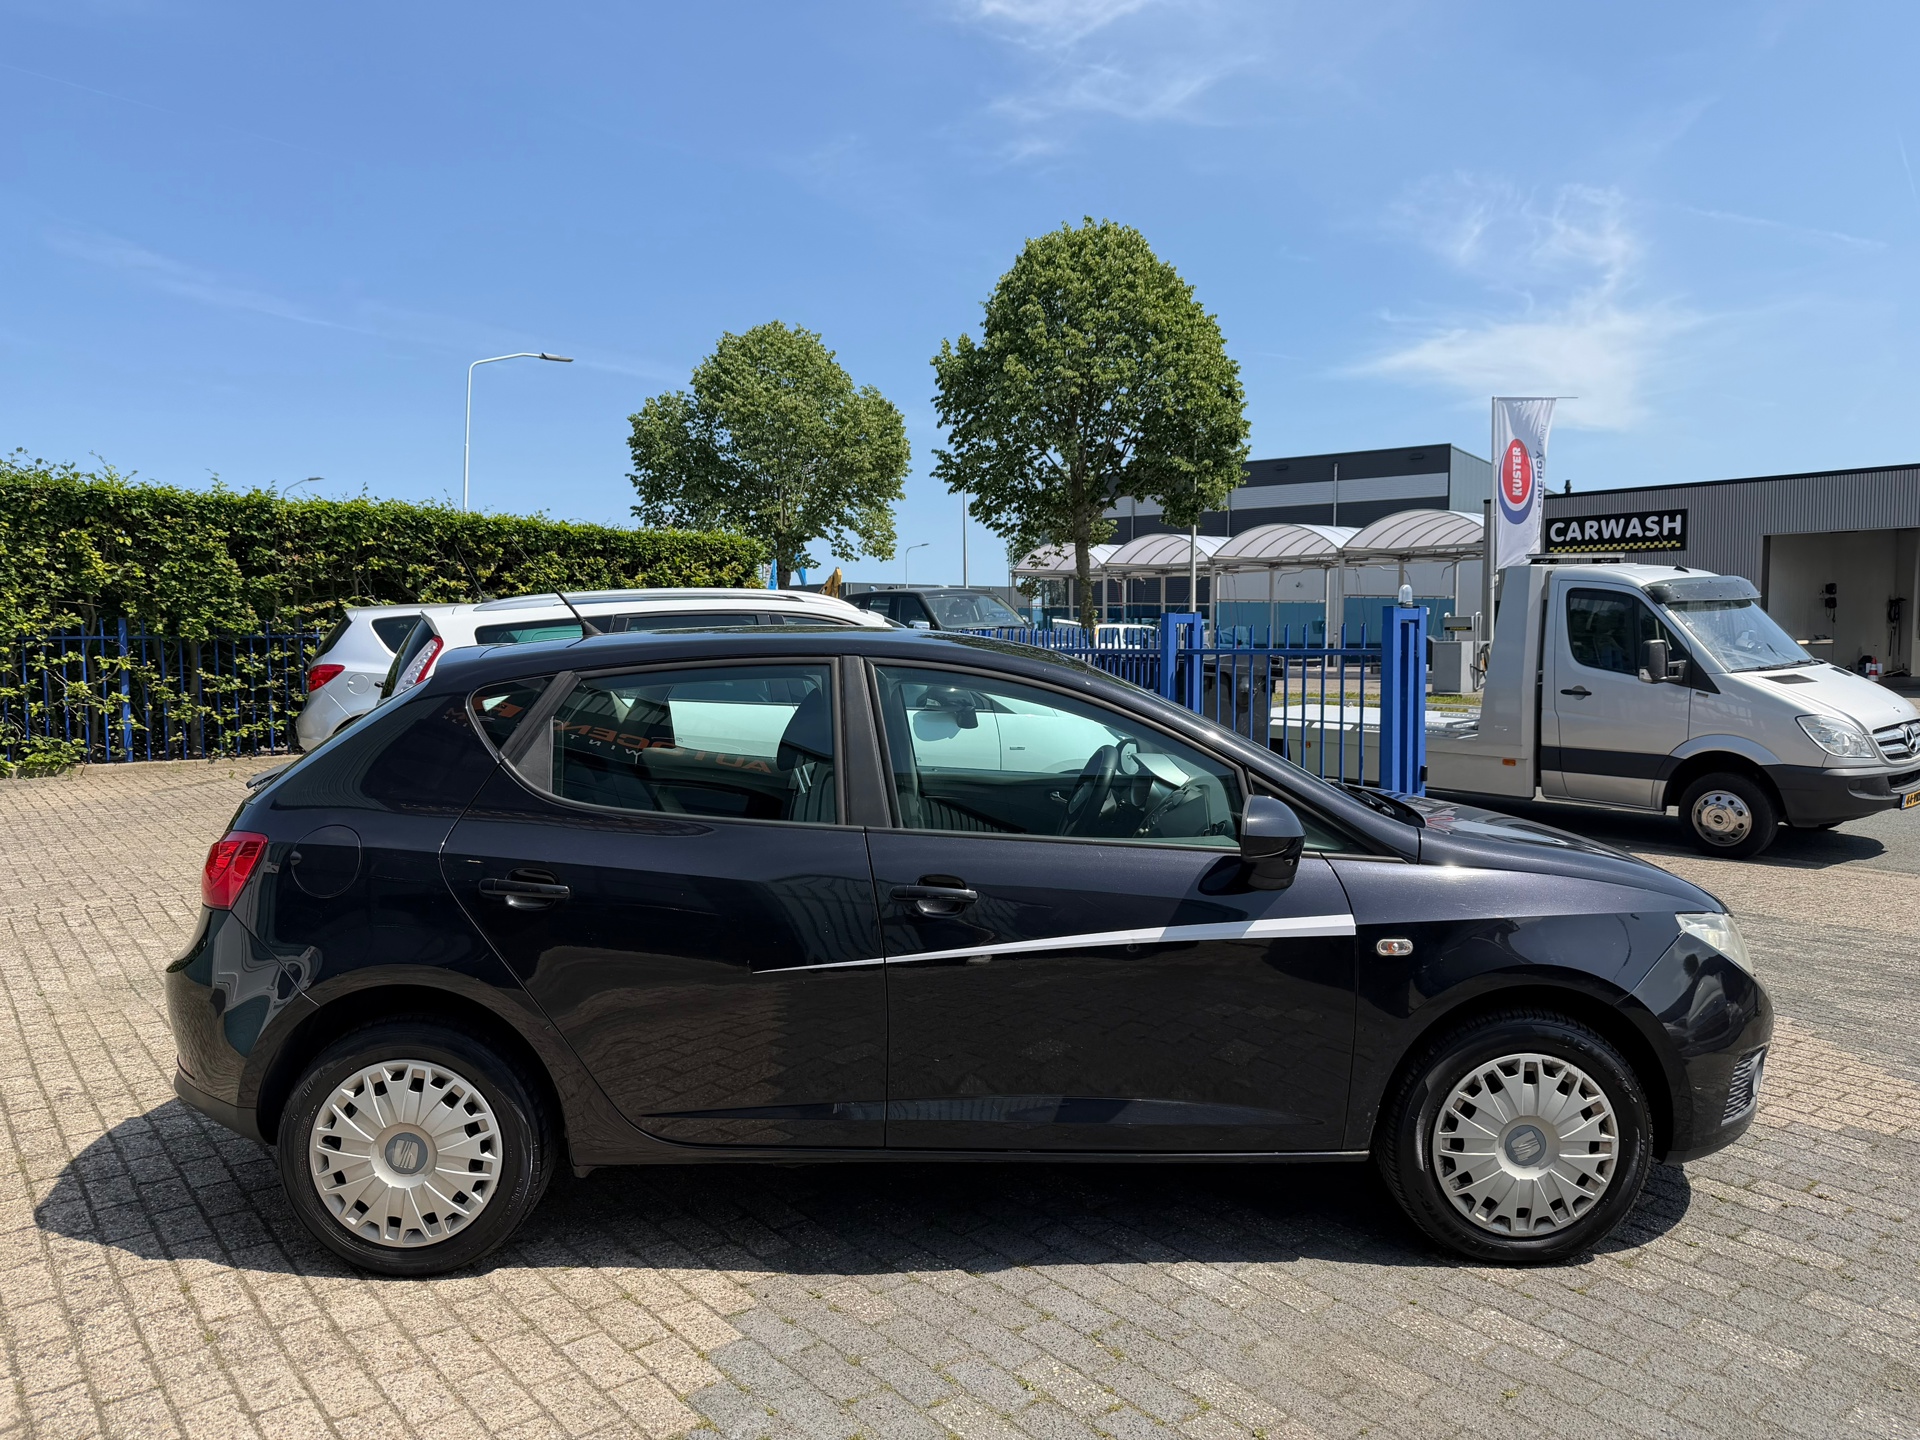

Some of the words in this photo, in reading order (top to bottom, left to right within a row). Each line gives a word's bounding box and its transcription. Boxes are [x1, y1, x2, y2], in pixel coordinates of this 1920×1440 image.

[1513, 447, 1523, 496] KUSTER
[1536, 450, 1544, 508] ENERGY
[1550, 515, 1682, 542] CARWASH
